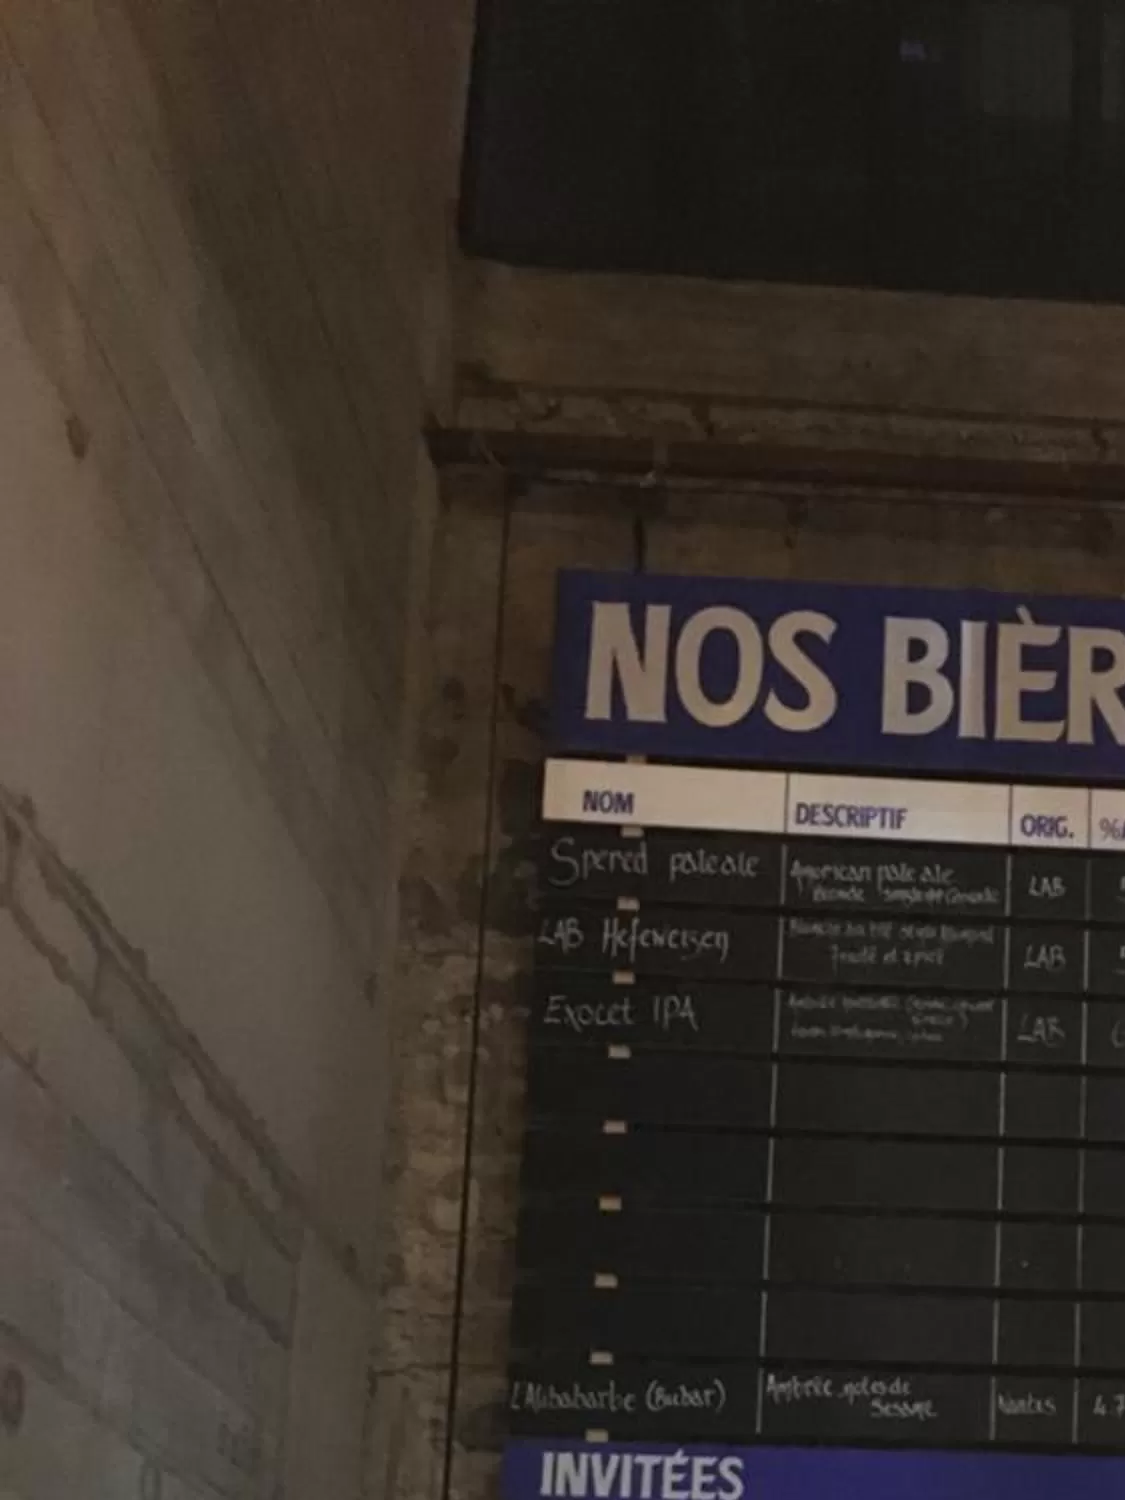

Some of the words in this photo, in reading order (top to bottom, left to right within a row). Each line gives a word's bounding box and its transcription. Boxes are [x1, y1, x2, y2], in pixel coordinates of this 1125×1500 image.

[583, 599, 840, 734] NOS
[582, 788, 637, 817] NOM
[796, 801, 909, 830] DESCRIPTIF
[1019, 815, 1075, 841] ORIG.
[652, 993, 700, 1032] IPA
